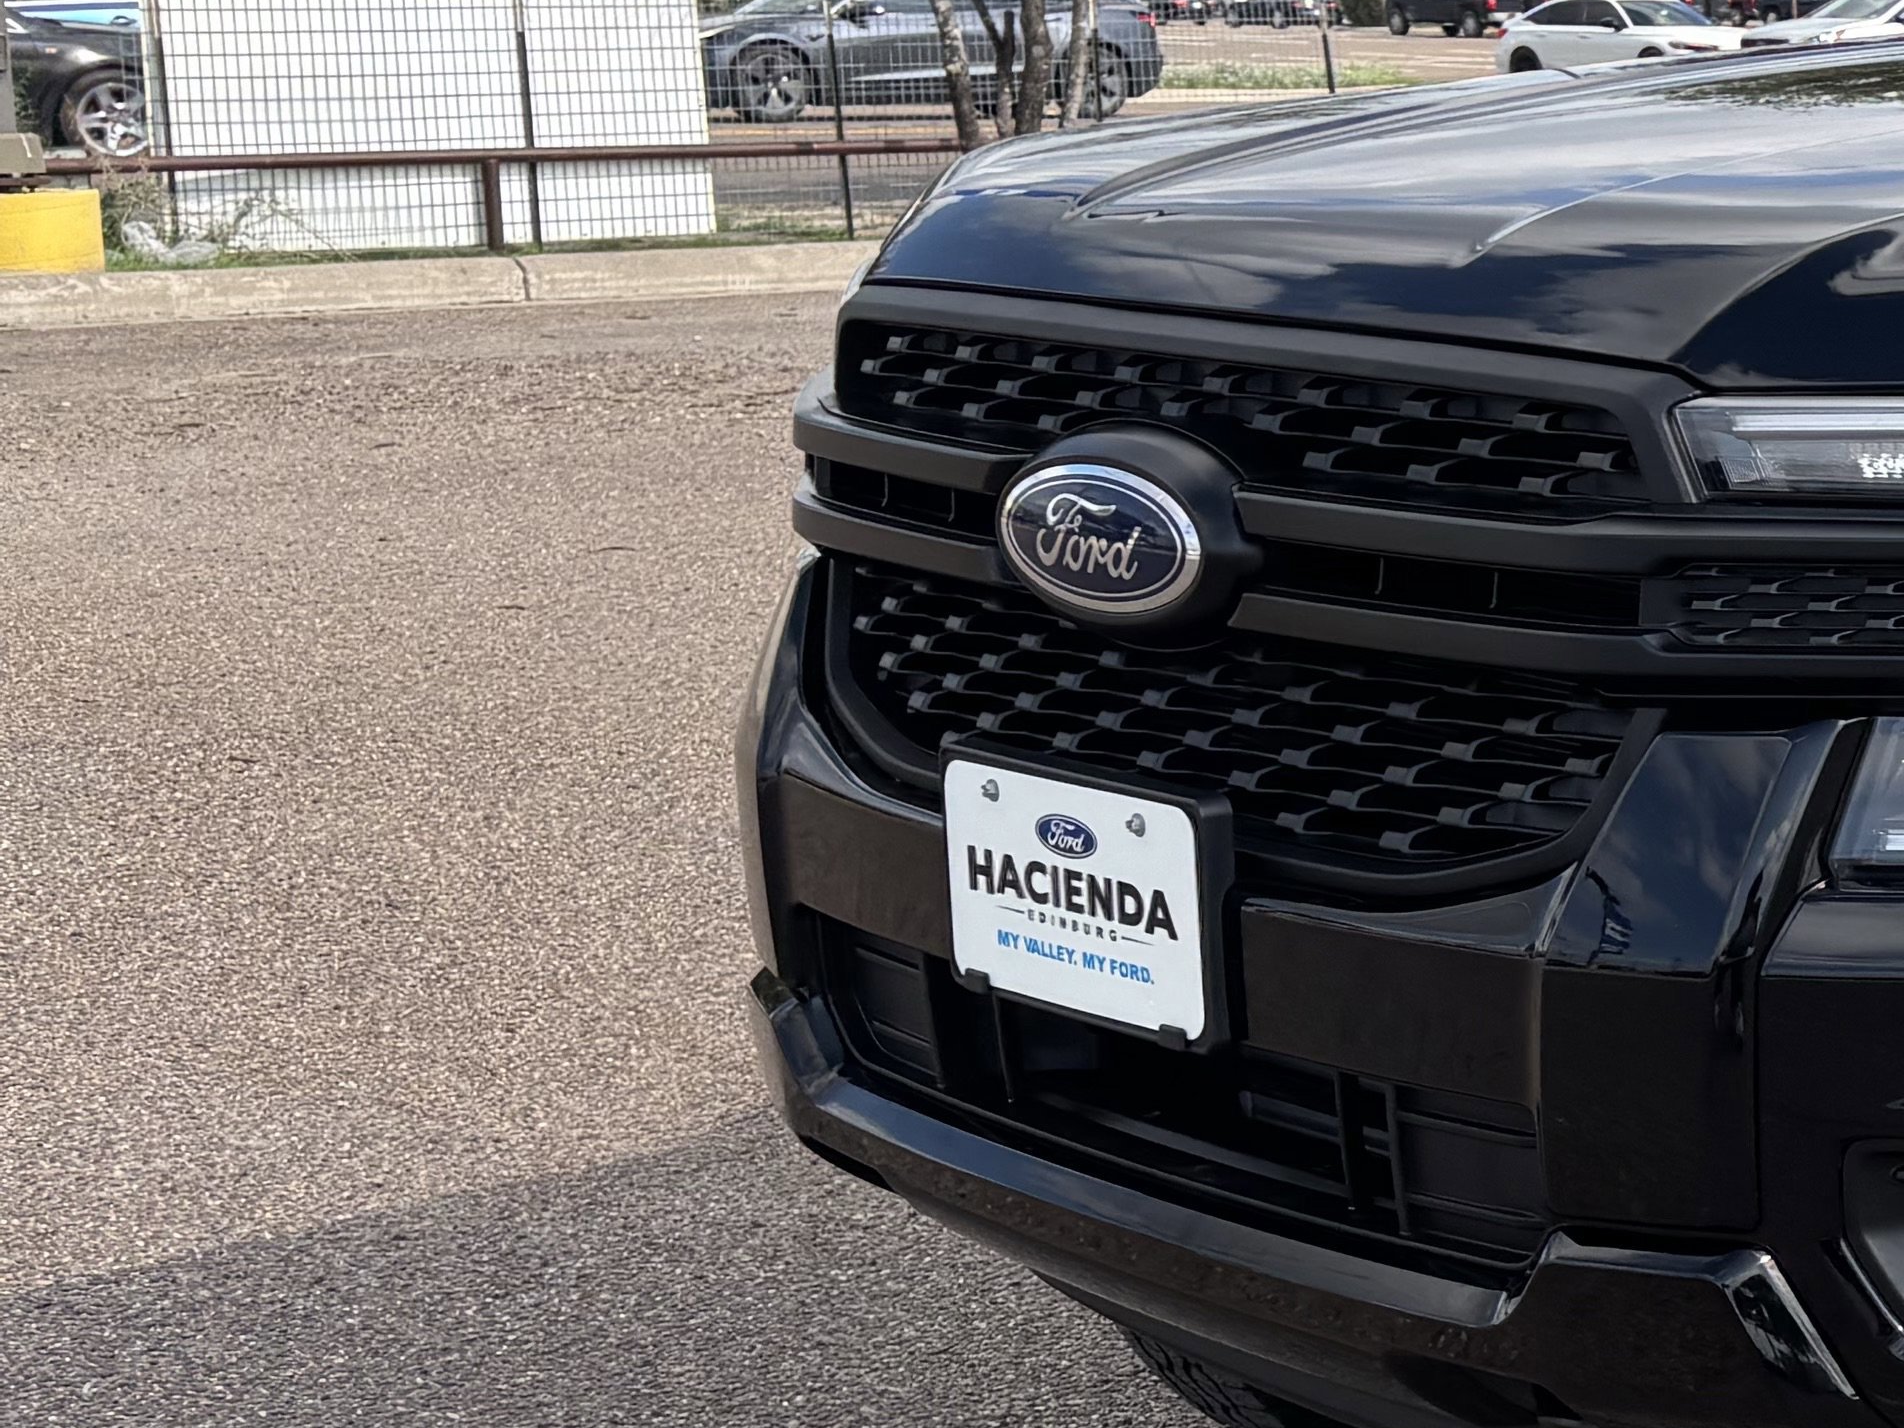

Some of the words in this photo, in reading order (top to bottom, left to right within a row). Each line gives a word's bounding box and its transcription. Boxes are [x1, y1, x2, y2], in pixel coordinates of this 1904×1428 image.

[1036, 492, 1143, 581] Ford
[1046, 819, 1087, 853] Ford
[966, 844, 1180, 942] HACIENDA
[1027, 908, 1119, 943] EDINBURG
[996, 928, 1019, 950] MY
[1023, 936, 1079, 966] VALLEY.
[1082, 951, 1107, 972] MY
[1109, 958, 1156, 985] FORD.
